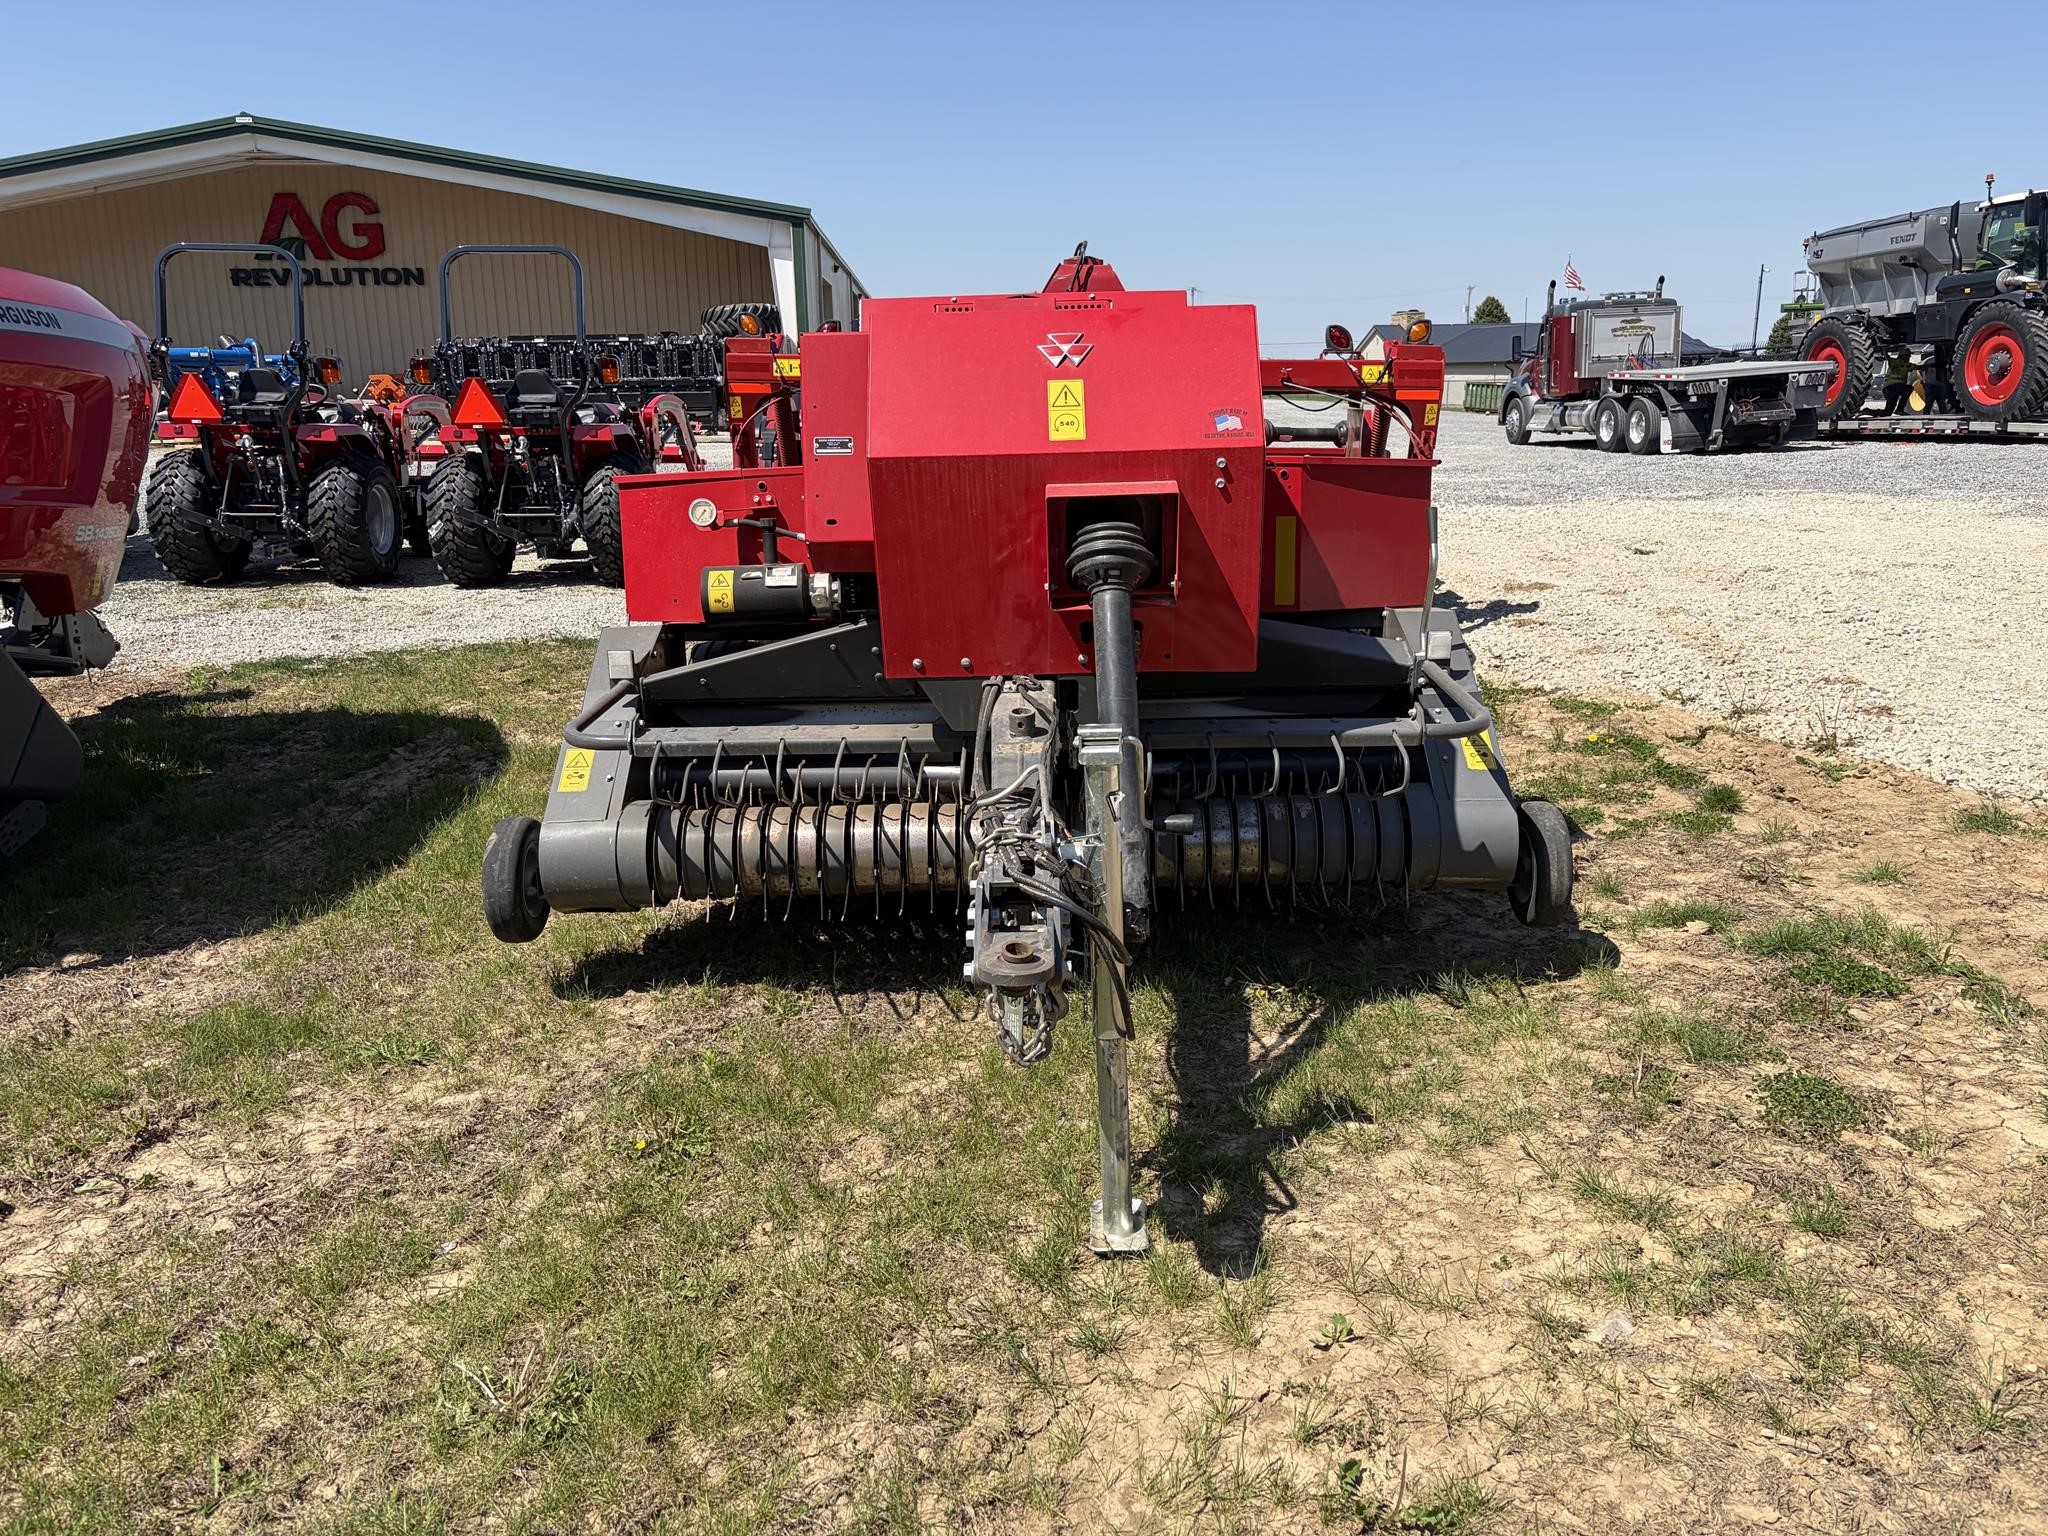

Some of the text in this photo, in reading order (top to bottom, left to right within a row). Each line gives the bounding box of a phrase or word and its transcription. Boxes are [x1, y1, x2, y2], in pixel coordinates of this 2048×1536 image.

[256, 192, 386, 260] AG
[1890, 233, 1918, 245] FENDT
[230, 267, 425, 286] REVOLUTION
